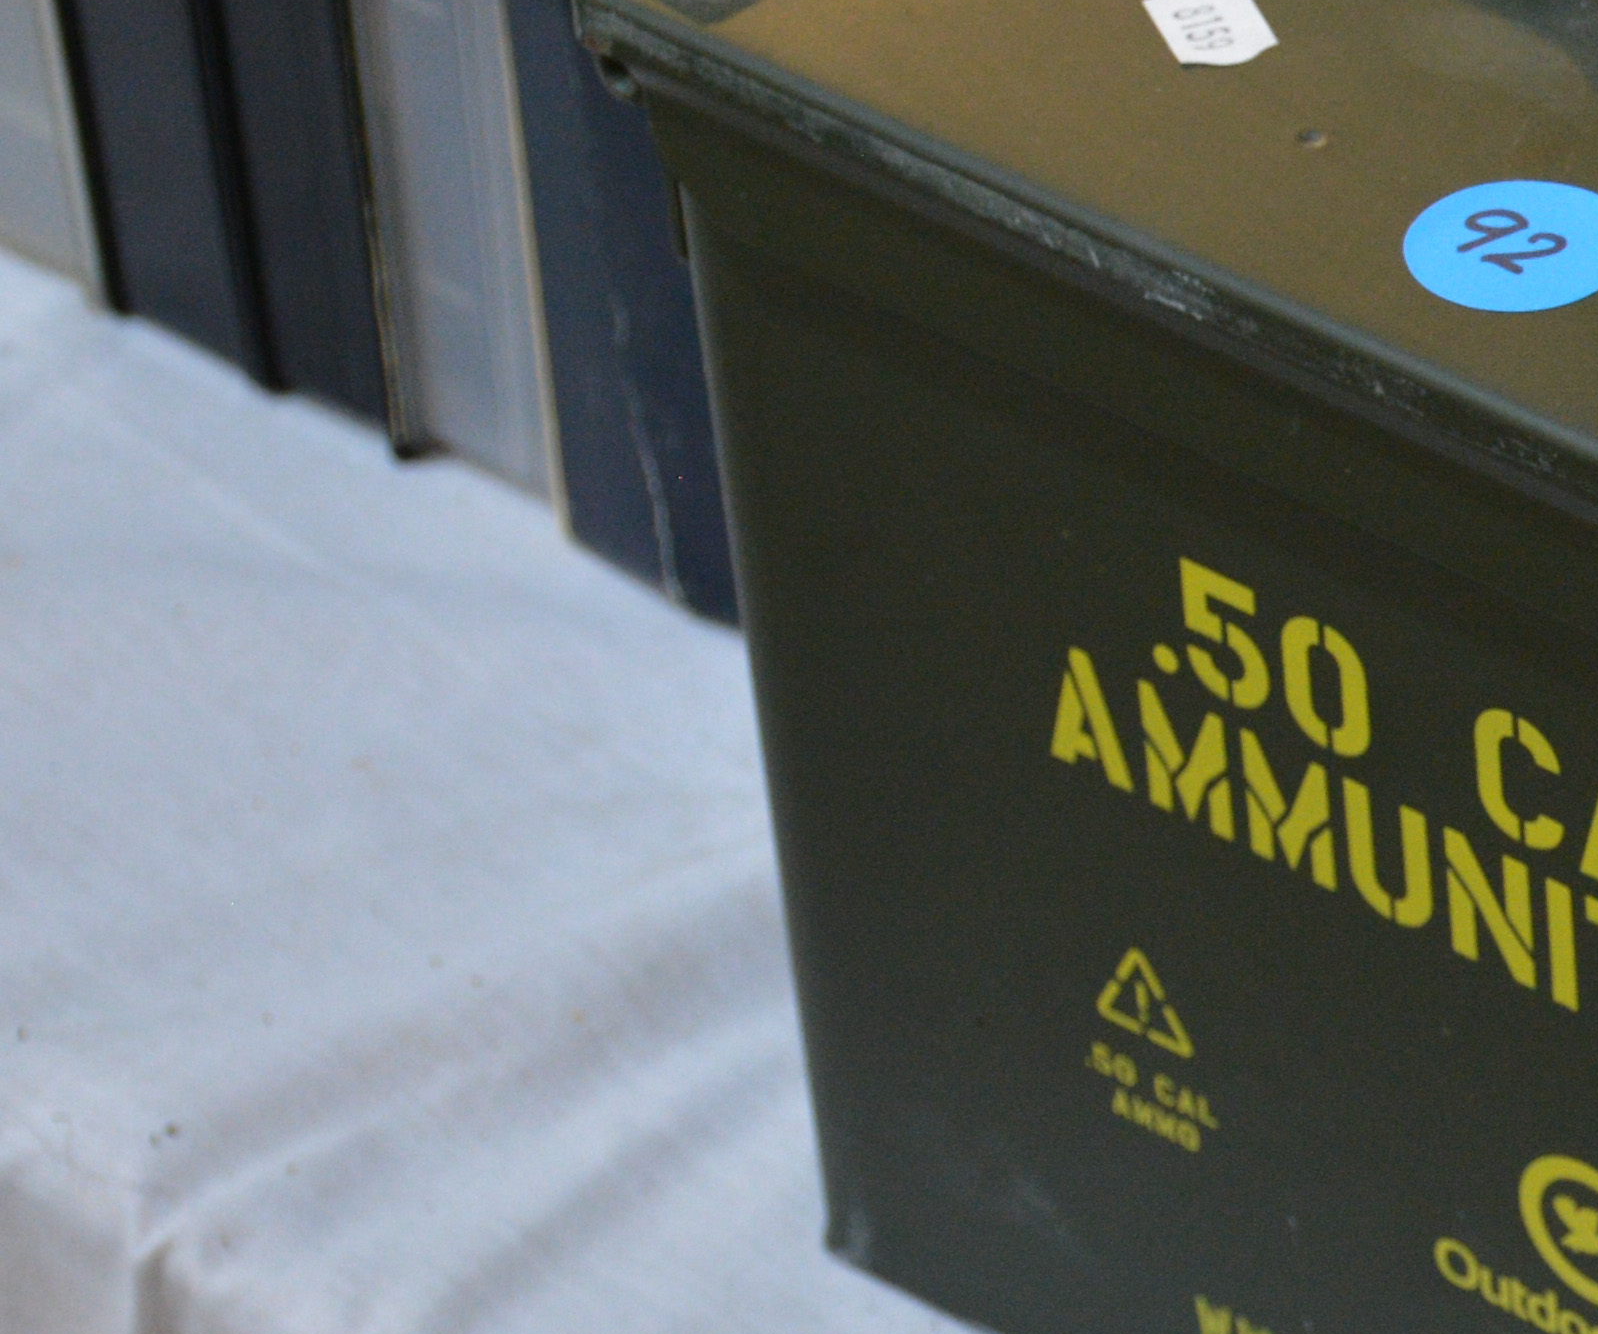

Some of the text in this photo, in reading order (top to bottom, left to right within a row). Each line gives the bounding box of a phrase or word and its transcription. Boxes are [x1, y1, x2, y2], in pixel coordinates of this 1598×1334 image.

[1456, 208, 1568, 276] 92
[1152, 555, 1374, 759] .50
[1153, 1072, 1219, 1130] CAL
